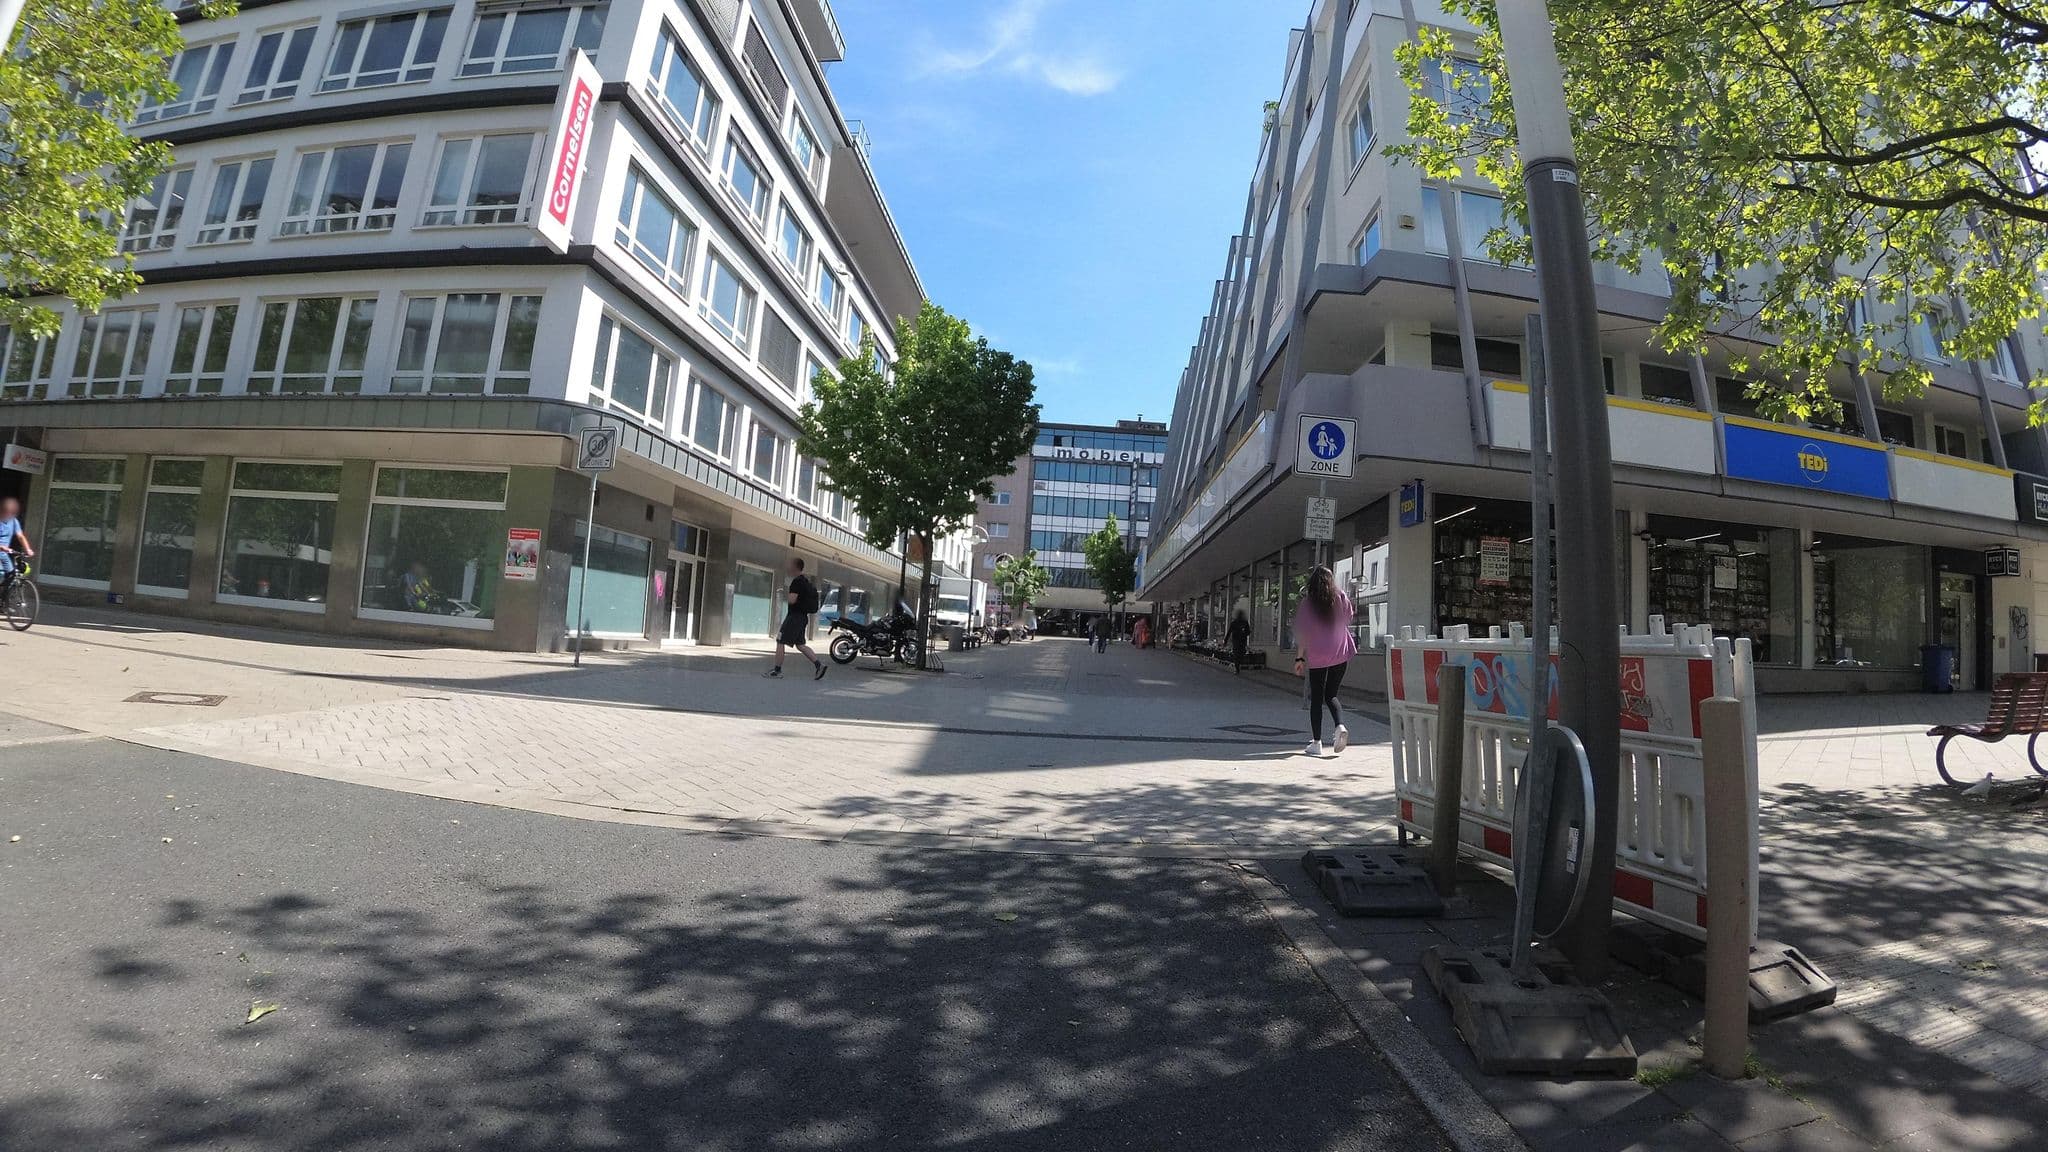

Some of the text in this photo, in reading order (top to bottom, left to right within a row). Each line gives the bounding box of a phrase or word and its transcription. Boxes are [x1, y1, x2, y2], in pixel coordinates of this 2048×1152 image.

[553, 91, 590, 214] Cornelsen
[591, 439, 604, 452] 30
[1310, 460, 1339, 473] ZONE
[1798, 452, 1828, 472] TEDi
